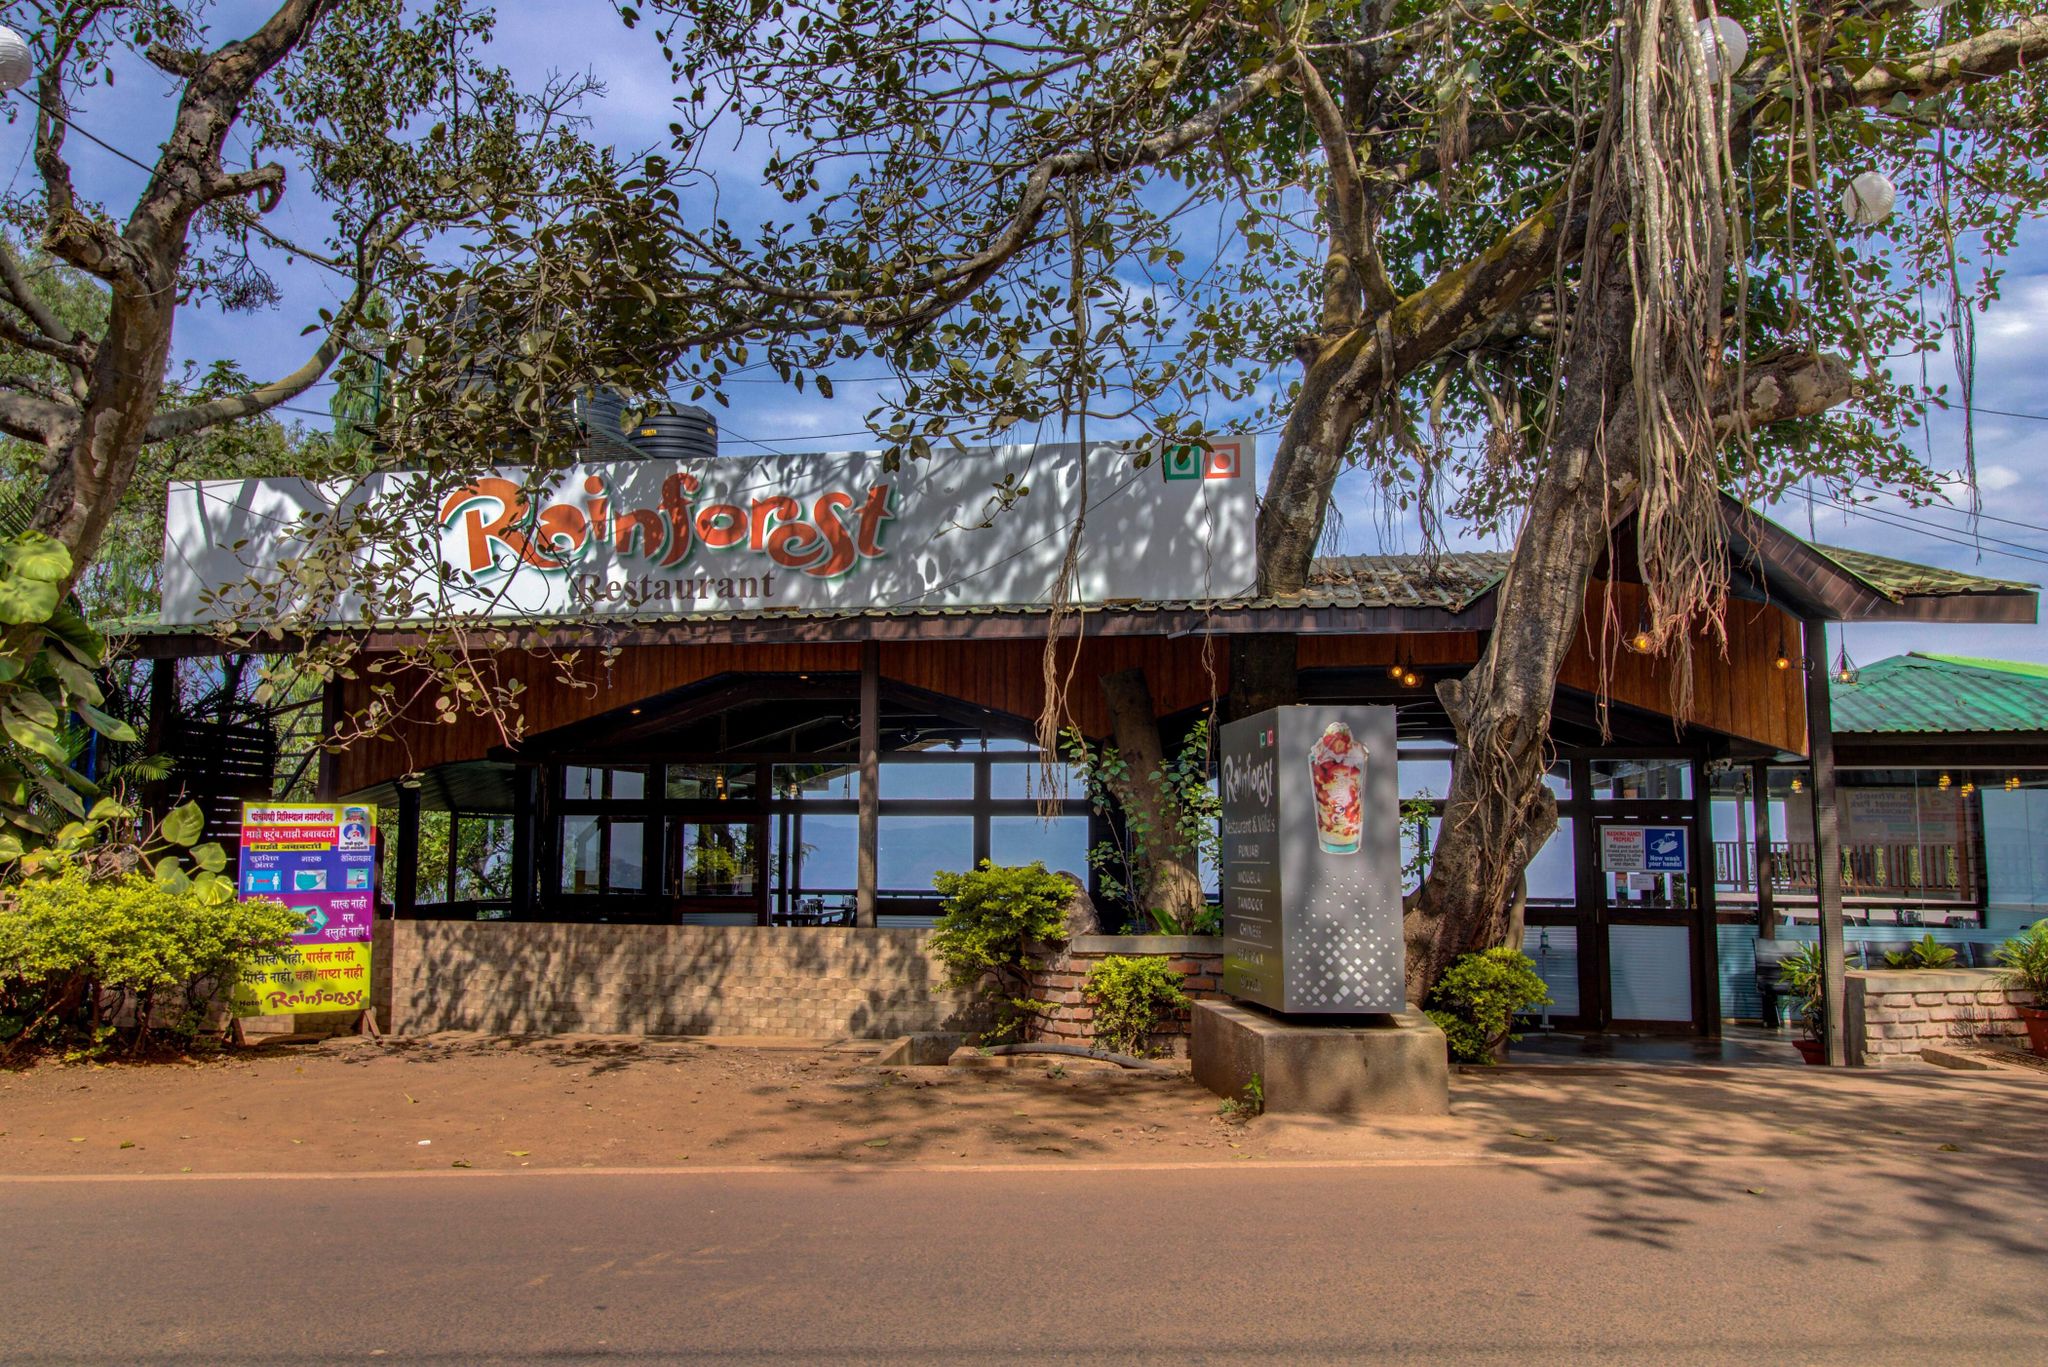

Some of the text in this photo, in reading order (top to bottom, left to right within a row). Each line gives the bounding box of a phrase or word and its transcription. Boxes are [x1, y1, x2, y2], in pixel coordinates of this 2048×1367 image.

[439, 472, 890, 579] Rainforest
[578, 570, 775, 603] Restaurant
[1222, 751, 1273, 808] Rainforest
[331, 896, 367, 911] मास्क नाही
[342, 913, 354, 923] मग
[347, 924, 365, 938] नाही
[305, 948, 332, 963] पार्सल
[334, 946, 355, 962] नाही
[269, 967, 294, 984] नाही,
[342, 964, 365, 980] नाही
[239, 988, 363, 1009] Hotel Rainforest
